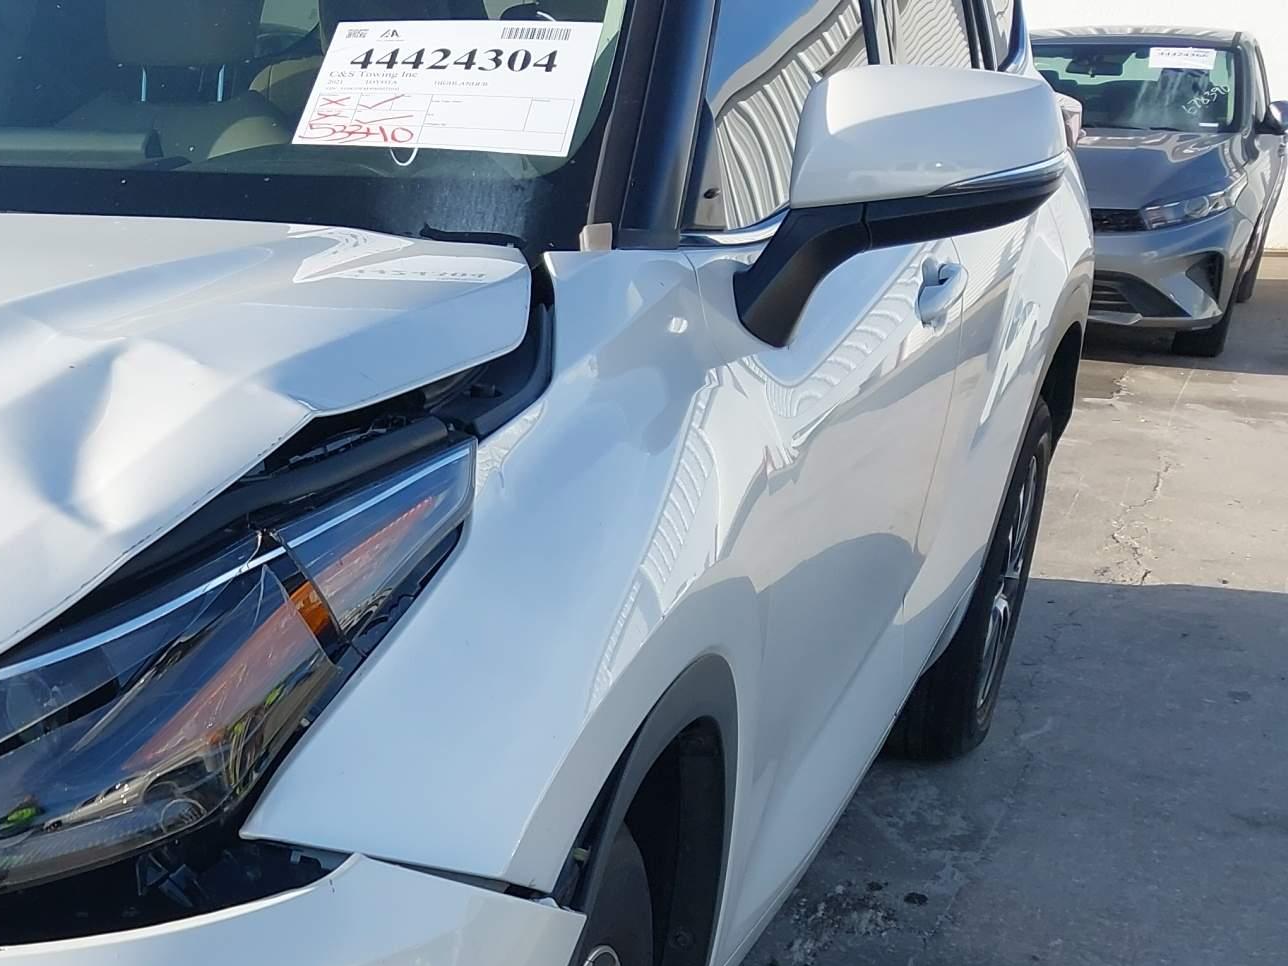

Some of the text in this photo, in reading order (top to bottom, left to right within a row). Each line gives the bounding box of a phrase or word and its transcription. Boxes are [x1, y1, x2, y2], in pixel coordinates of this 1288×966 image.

[350, 47, 559, 73] 44424304
[328, 70, 418, 80] C&S Towing Inc
